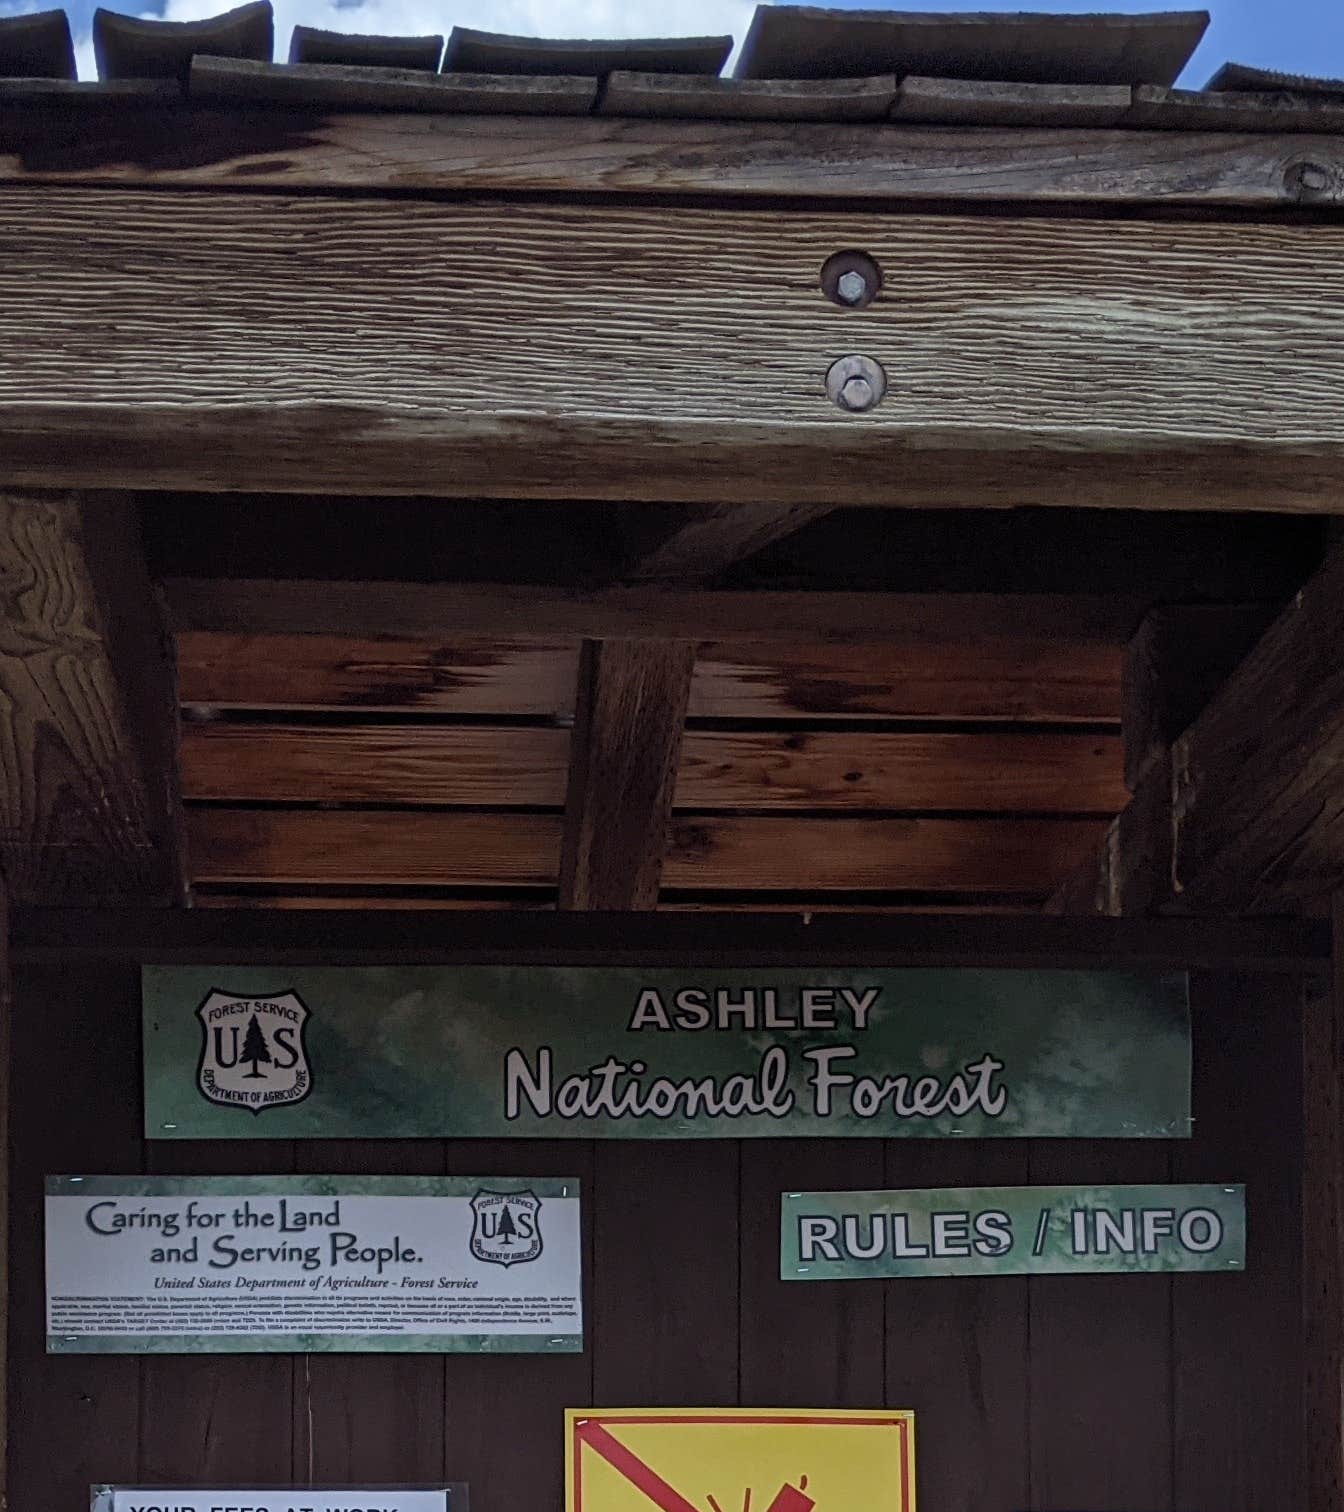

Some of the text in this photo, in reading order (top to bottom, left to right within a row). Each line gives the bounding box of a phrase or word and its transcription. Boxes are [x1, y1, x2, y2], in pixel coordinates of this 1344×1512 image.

[209, 1002, 299, 1023] FOREST SERVICE
[627, 986, 881, 1032] ASHLEY
[203, 1069, 307, 1102] DEPARTMENT OF AGRICULTURE
[505, 1045, 1007, 1121] National Forest
[86, 1199, 340, 1232] Caring for the Land
[477, 1198, 503, 1210] FOREST
[798, 1210, 1014, 1261] RULES
[1072, 1208, 1224, 1255] INFO
[150, 1232, 423, 1274] and Serving People.
[154, 1277, 196, 1289] United
[197, 1276, 231, 1289] States
[235, 1276, 306, 1291] Department
[309, 1275, 324, 1290] of
[323, 1276, 389, 1290] Agriculture
[400, 1277, 435, 1289] Forest
[437, 1277, 479, 1289] Service
